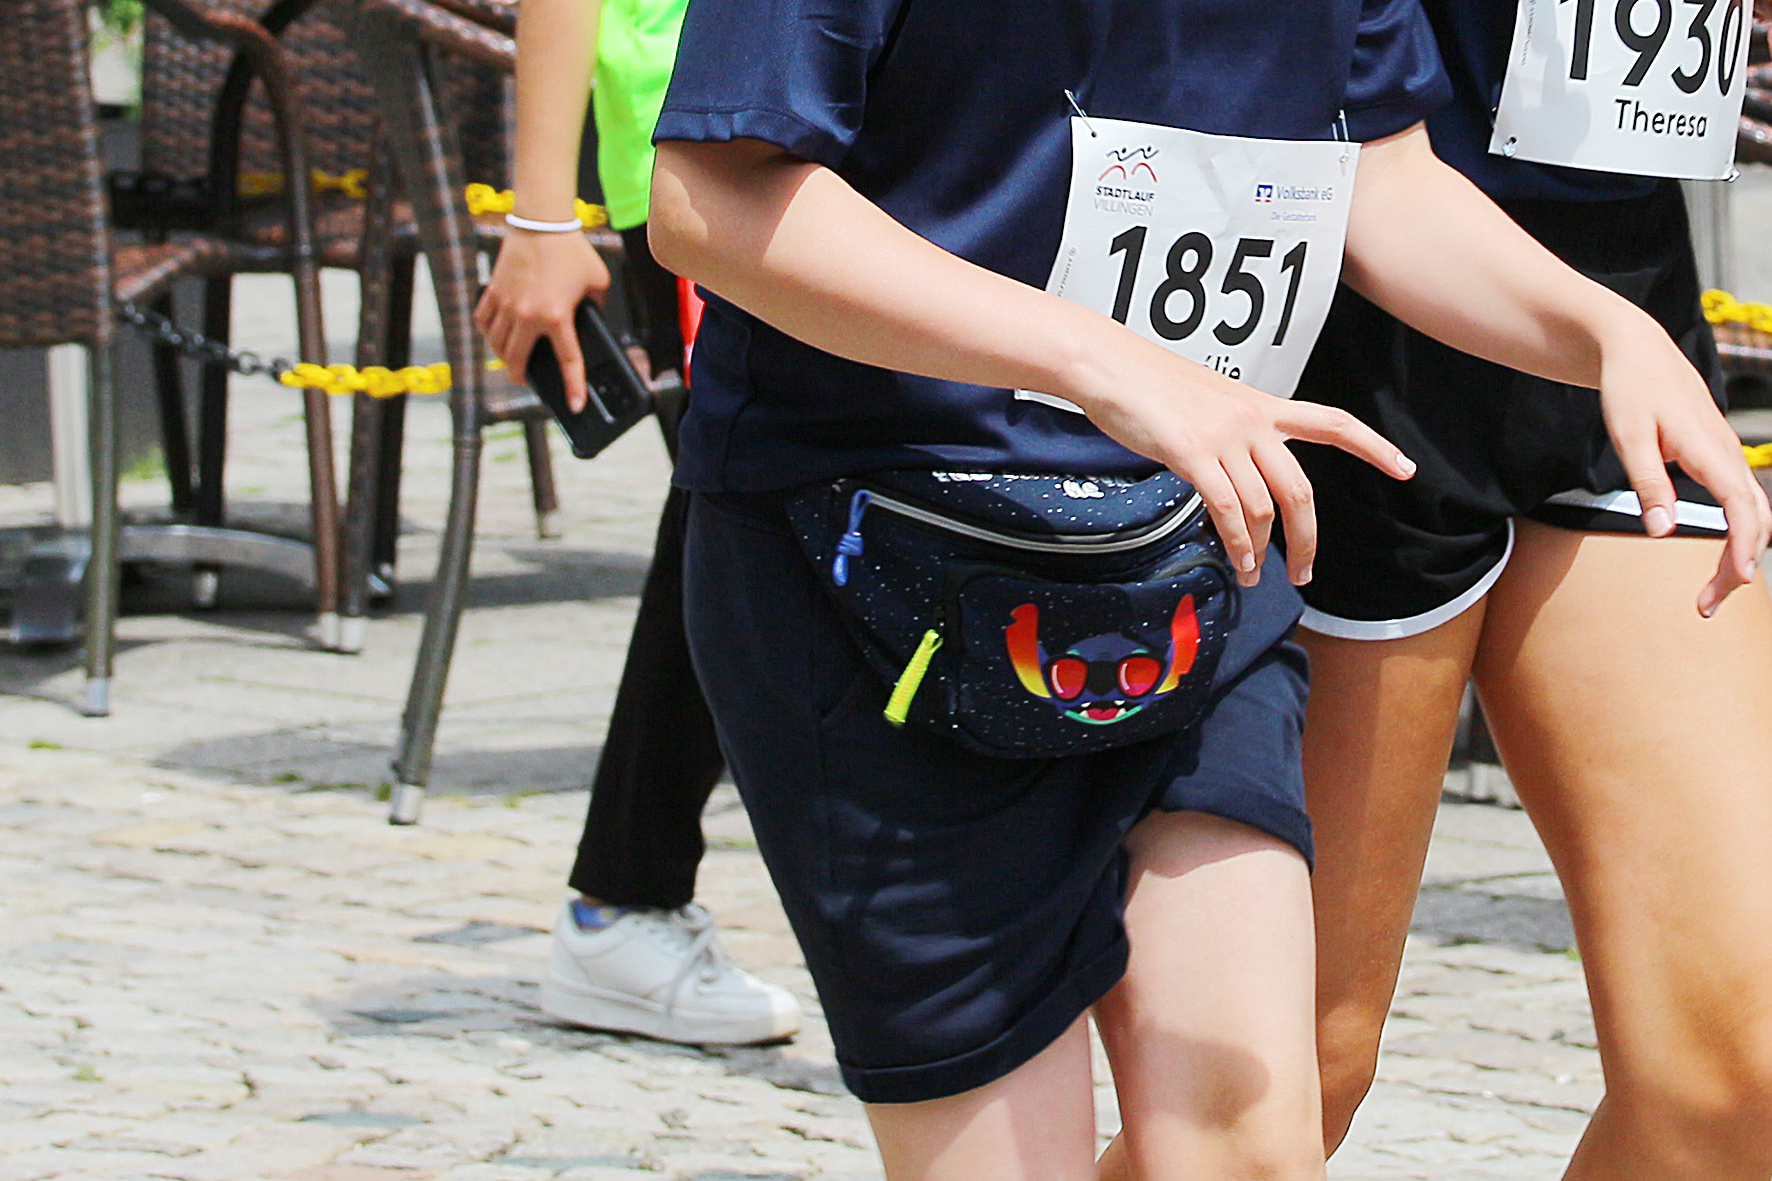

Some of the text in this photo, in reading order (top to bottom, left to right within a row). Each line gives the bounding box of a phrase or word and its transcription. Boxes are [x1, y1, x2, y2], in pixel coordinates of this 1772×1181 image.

[1615, 99, 1708, 137] Theresa
[1096, 186, 1155, 201] STADTLAUF
[1109, 225, 1309, 347] 1851
